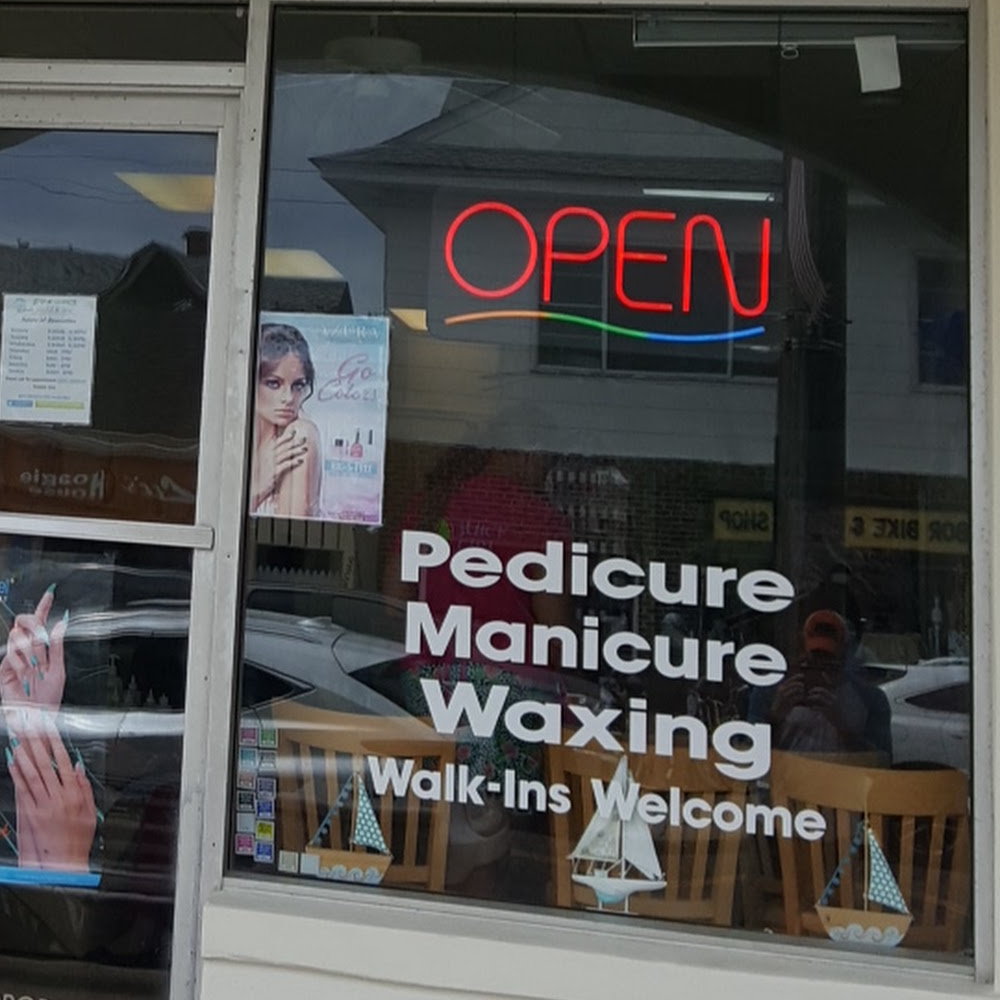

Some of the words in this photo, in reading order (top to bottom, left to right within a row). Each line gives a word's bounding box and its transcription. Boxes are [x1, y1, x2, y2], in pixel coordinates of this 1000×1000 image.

[445, 202, 771, 318] OPEN
[338, 354, 374, 382] Go
[400, 530, 796, 613] Pedicure
[404, 601, 788, 687] Manicure
[420, 678, 772, 781] Waxing
[366, 755, 572, 814] Walk-Ins
[591, 778, 827, 841] Welcome
